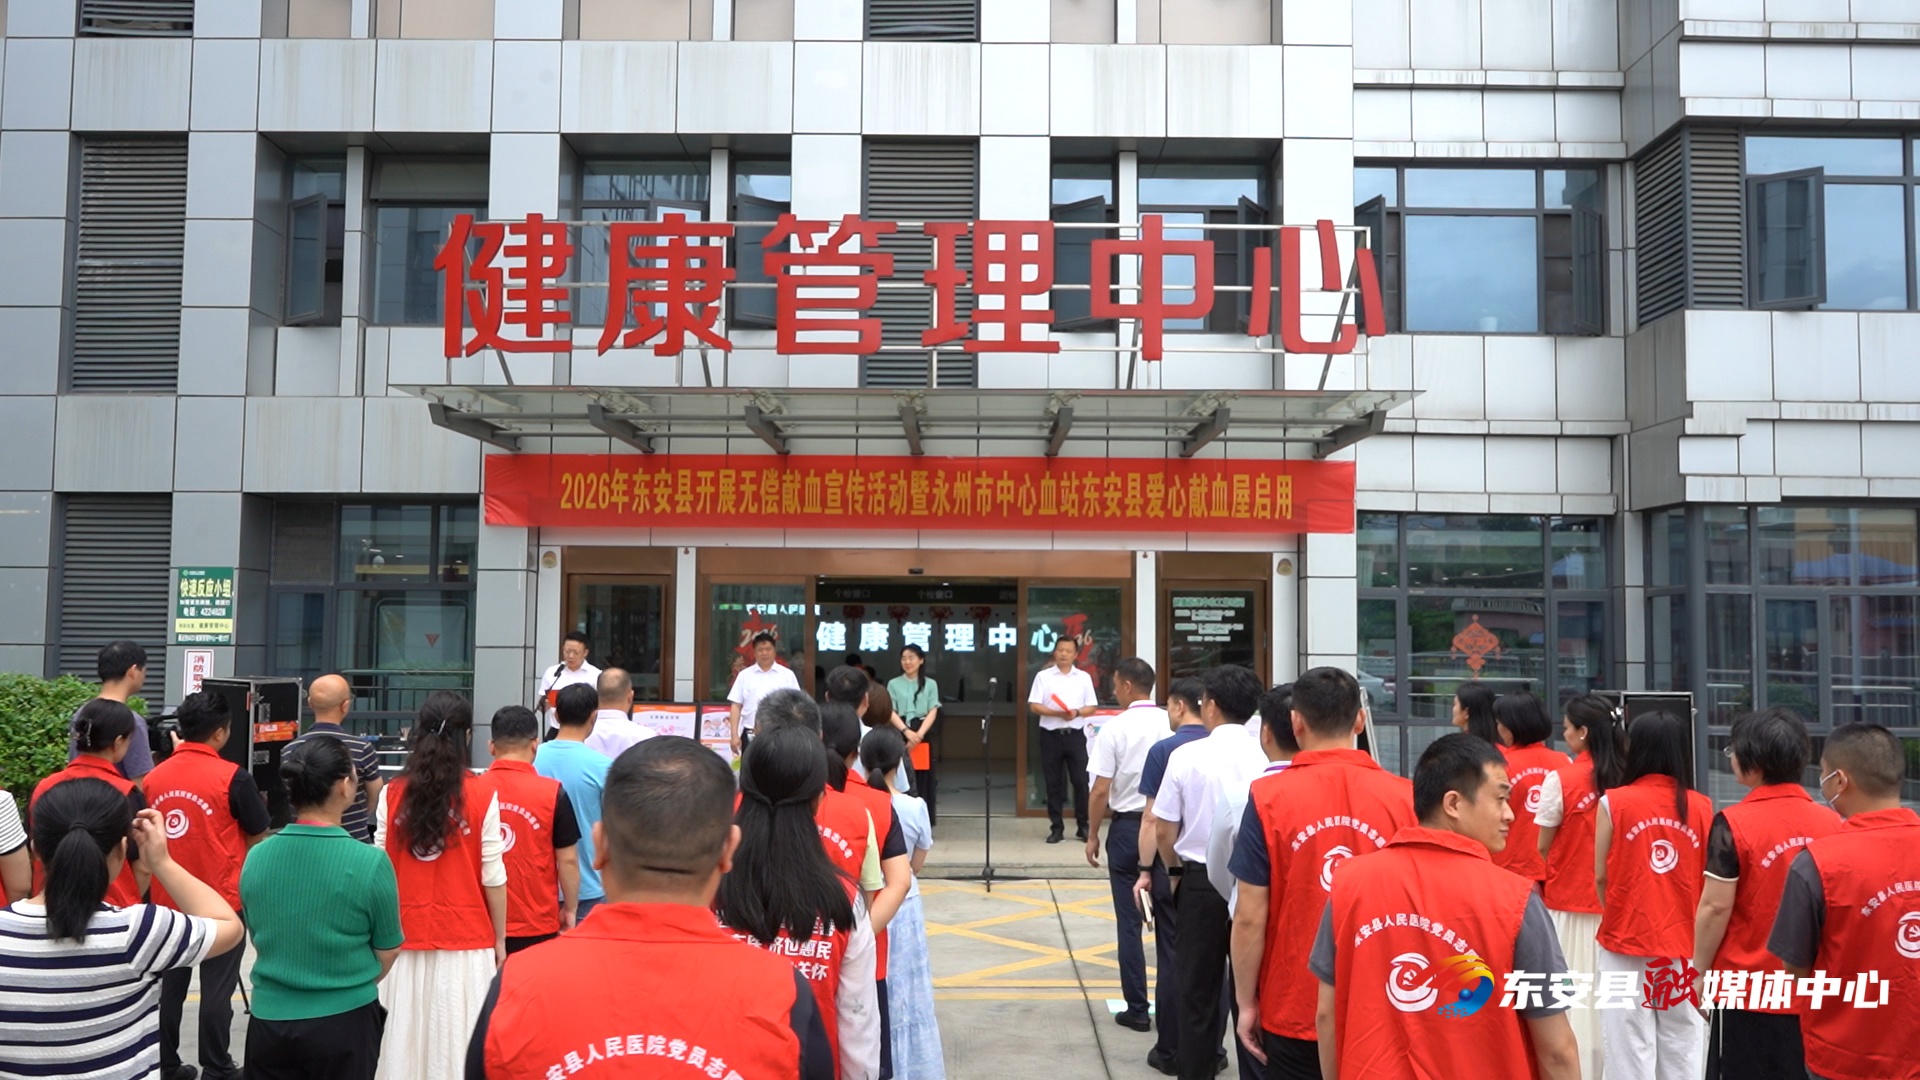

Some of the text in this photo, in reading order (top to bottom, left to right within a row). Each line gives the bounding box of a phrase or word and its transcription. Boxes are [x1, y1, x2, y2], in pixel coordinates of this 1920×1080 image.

[433, 212, 1387, 360] 健康管理中心
[560, 468, 1293, 520] 2026年东安县开展无偿献血宣传活动暨永州市中心血站东安县爱心献血屋启用
[816, 621, 1058, 653] 健康管理中心
[792, 961, 829, 980] 关怀
